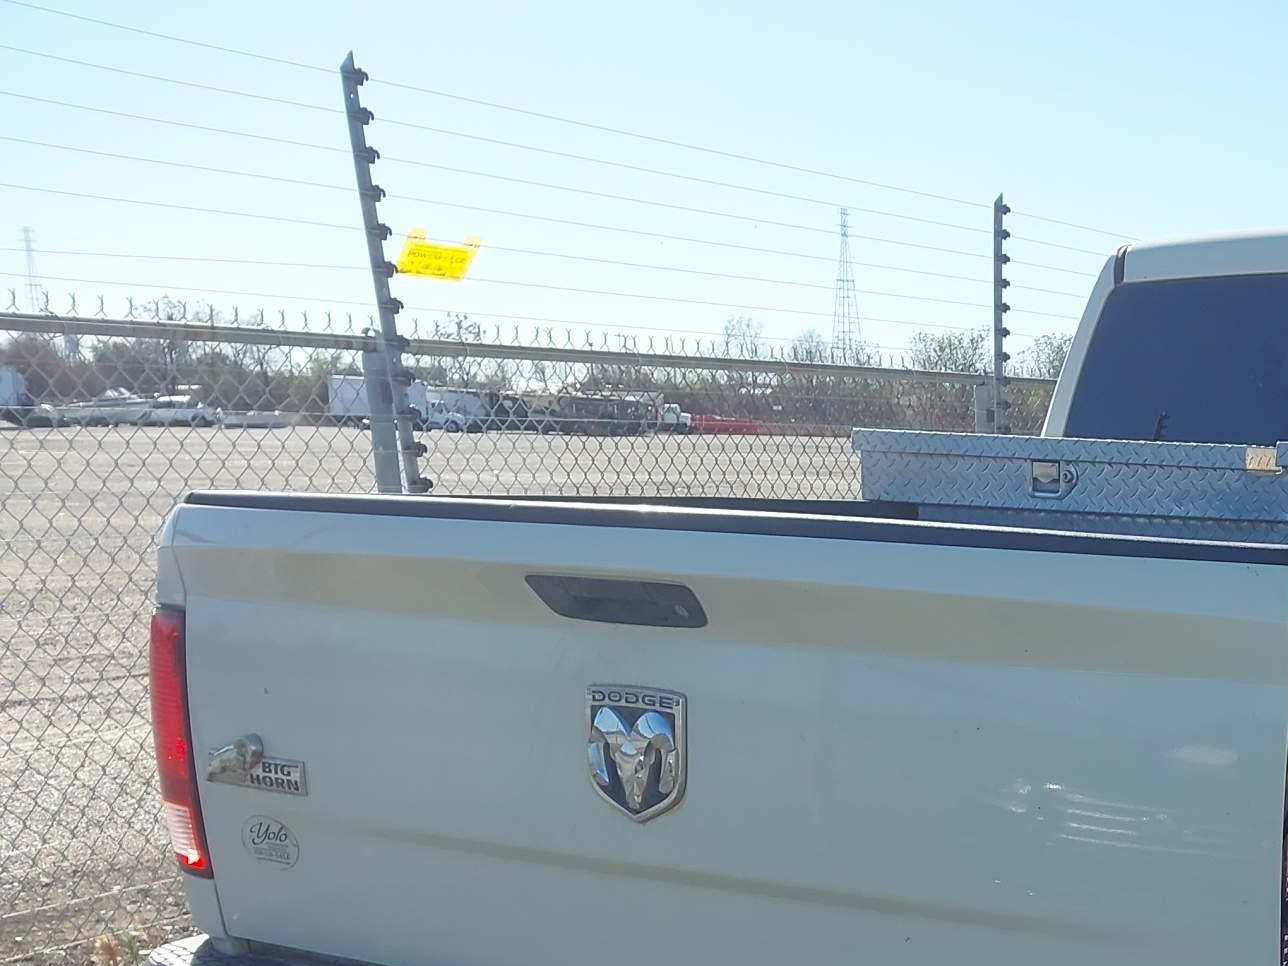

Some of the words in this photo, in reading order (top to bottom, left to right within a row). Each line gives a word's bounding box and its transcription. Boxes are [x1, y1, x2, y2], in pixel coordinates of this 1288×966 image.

[591, 690, 674, 709] DODGE
[261, 761, 291, 777] BIG
[250, 773, 300, 792] HORN
[249, 821, 289, 846] Yolo
